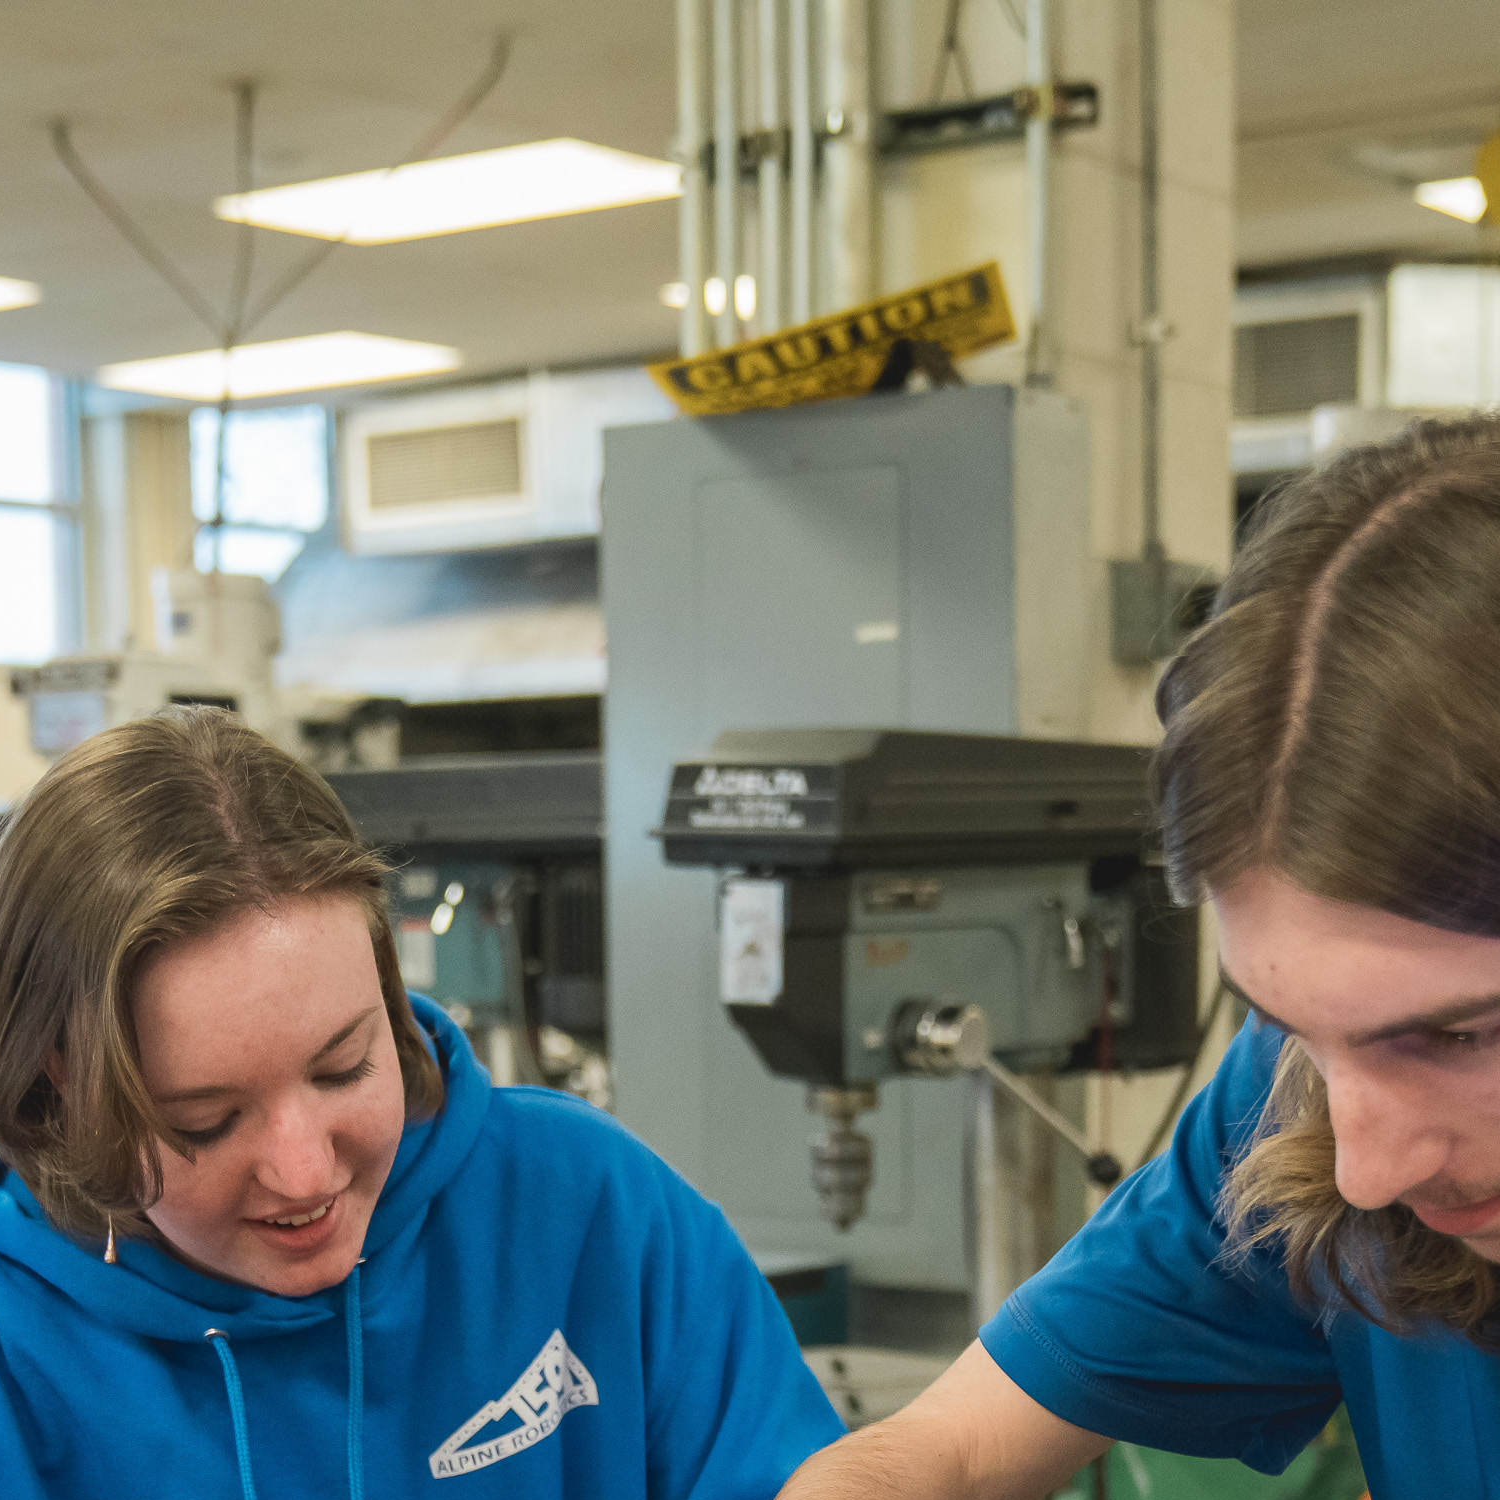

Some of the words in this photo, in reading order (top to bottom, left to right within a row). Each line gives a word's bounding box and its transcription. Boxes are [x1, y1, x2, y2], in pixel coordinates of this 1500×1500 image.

[686, 278, 974, 391] CAUTION
[436, 1442, 508, 1475] ALPINE
[511, 1389, 590, 1449] ROBOCS
